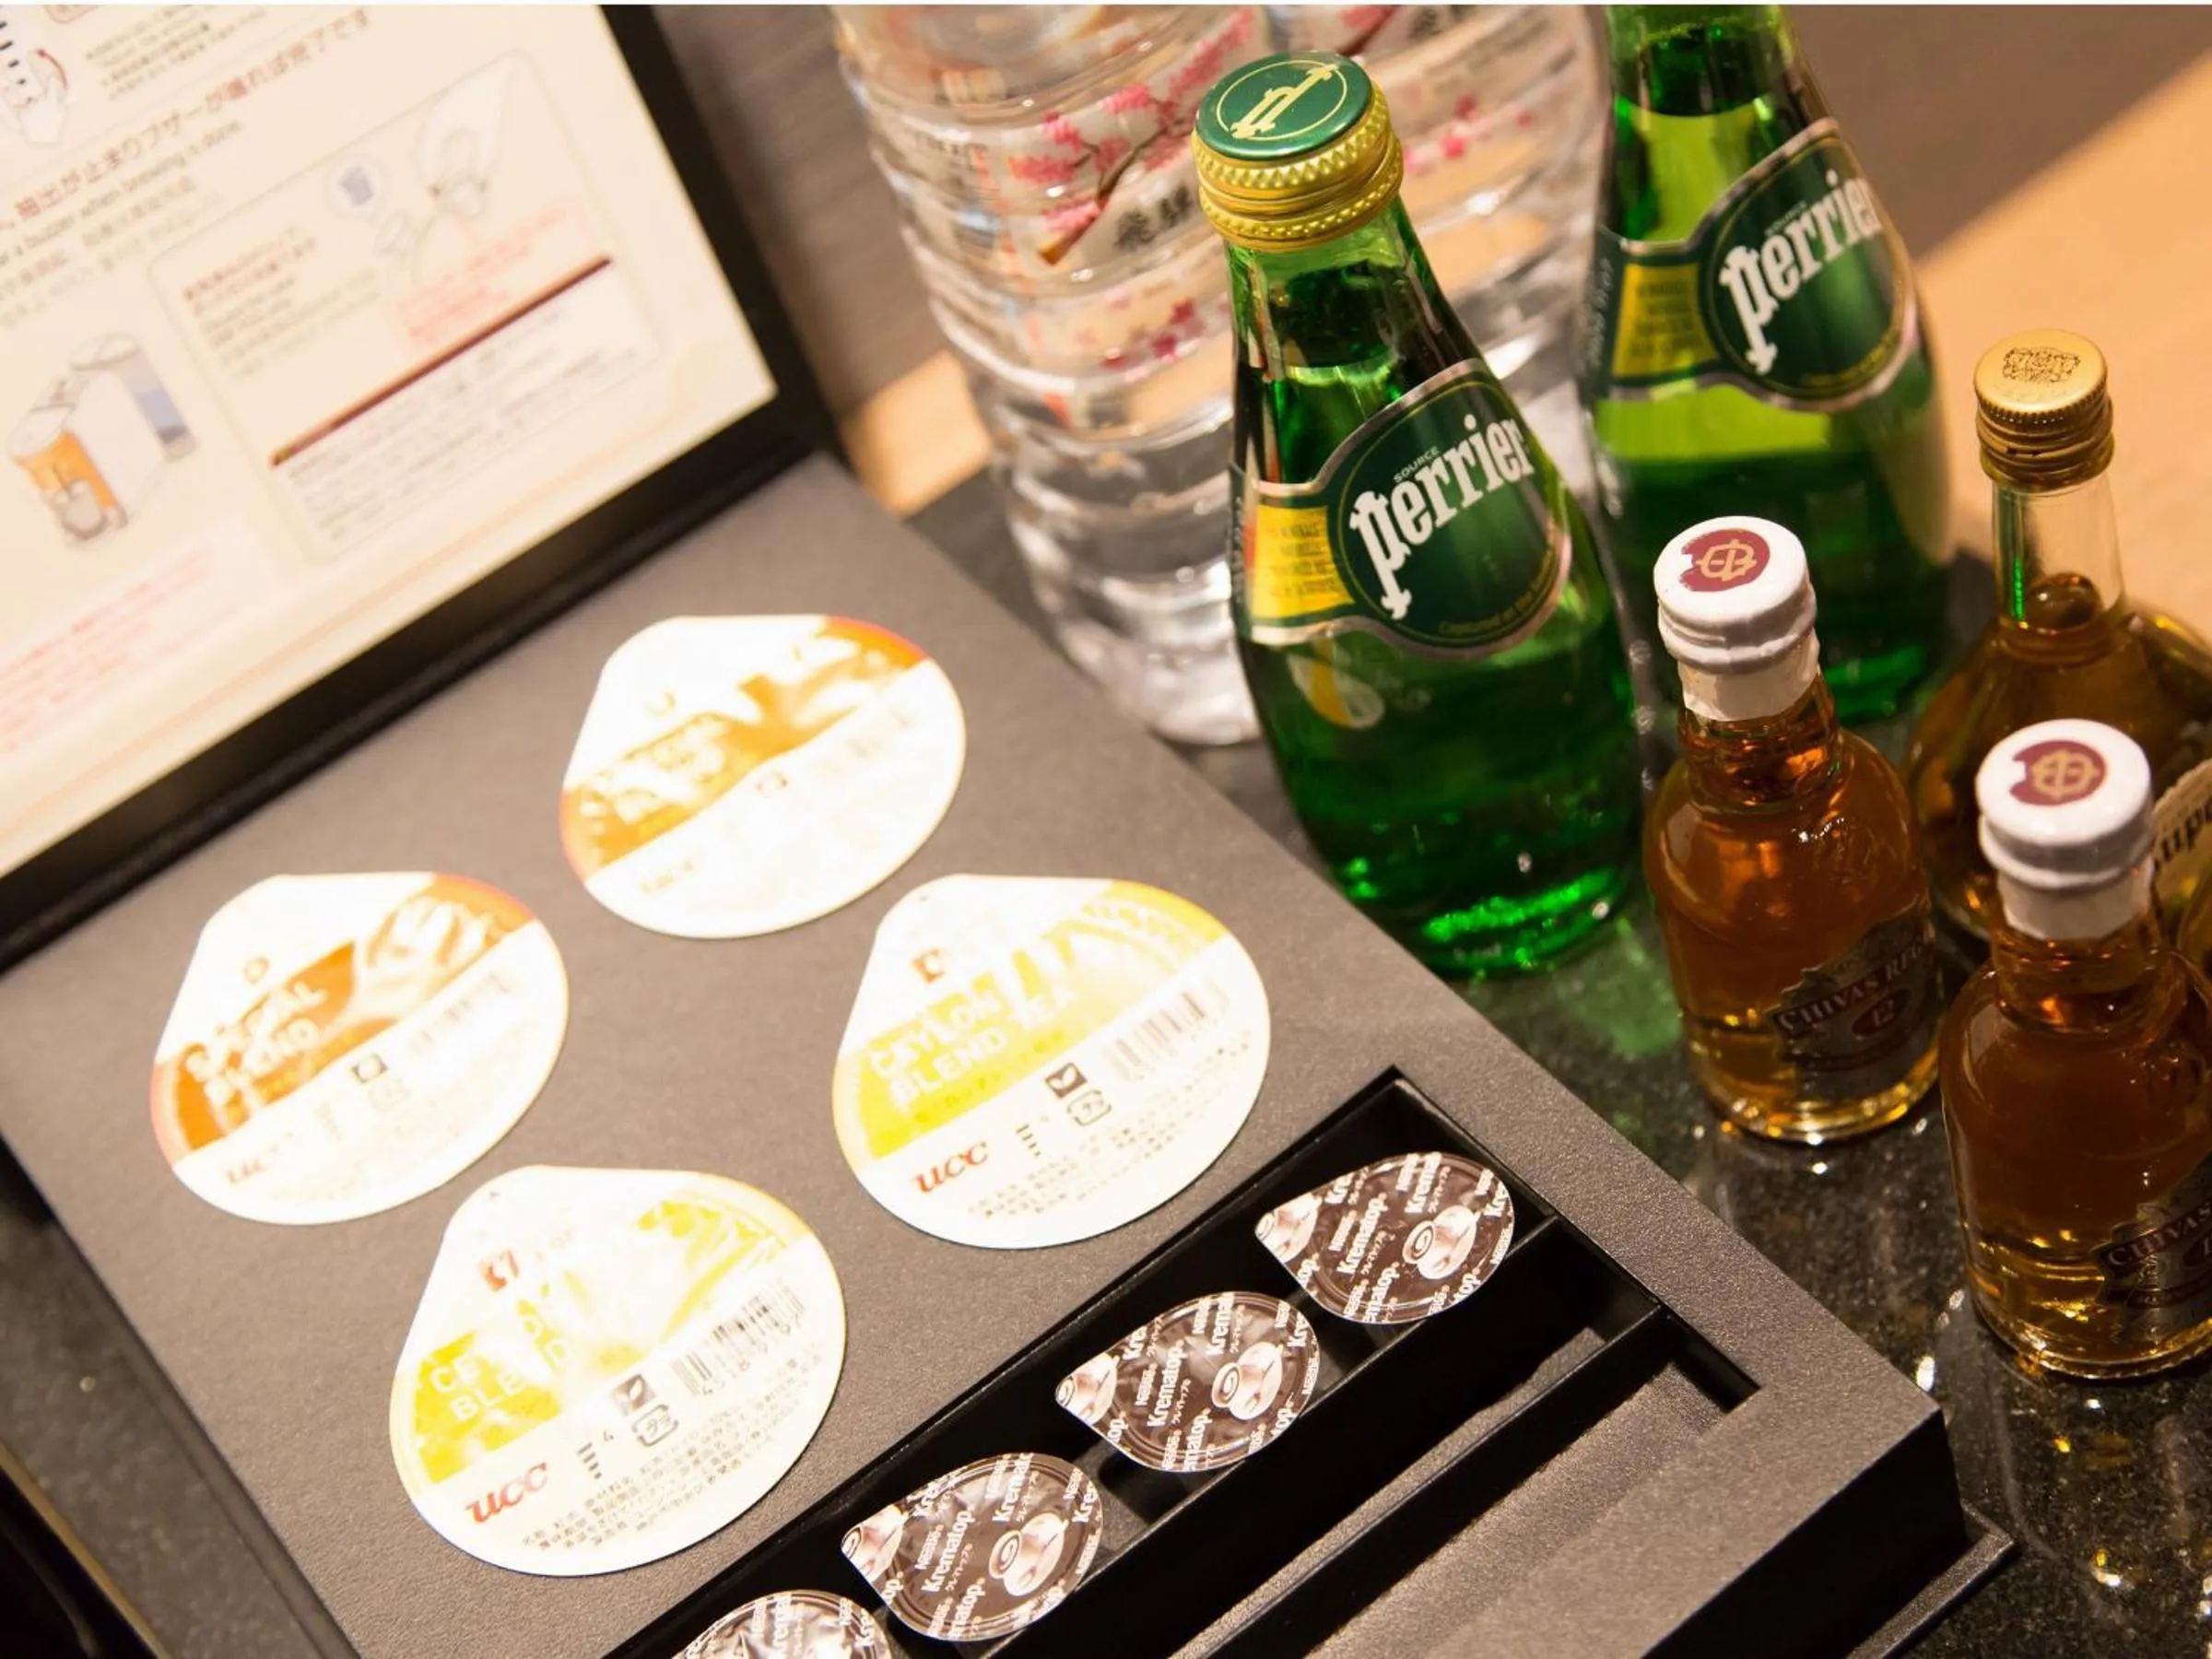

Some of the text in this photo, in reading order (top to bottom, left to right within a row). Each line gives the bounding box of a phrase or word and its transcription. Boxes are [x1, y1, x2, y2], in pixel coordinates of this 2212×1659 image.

[1393, 446, 1441, 484] SOURCE
[1778, 977, 1880, 1034] CHIVAS
[1337, 1196, 1388, 1274] Krematop
[1147, 1345, 1188, 1427] Krematop
[922, 1511, 975, 1593] Krematop
